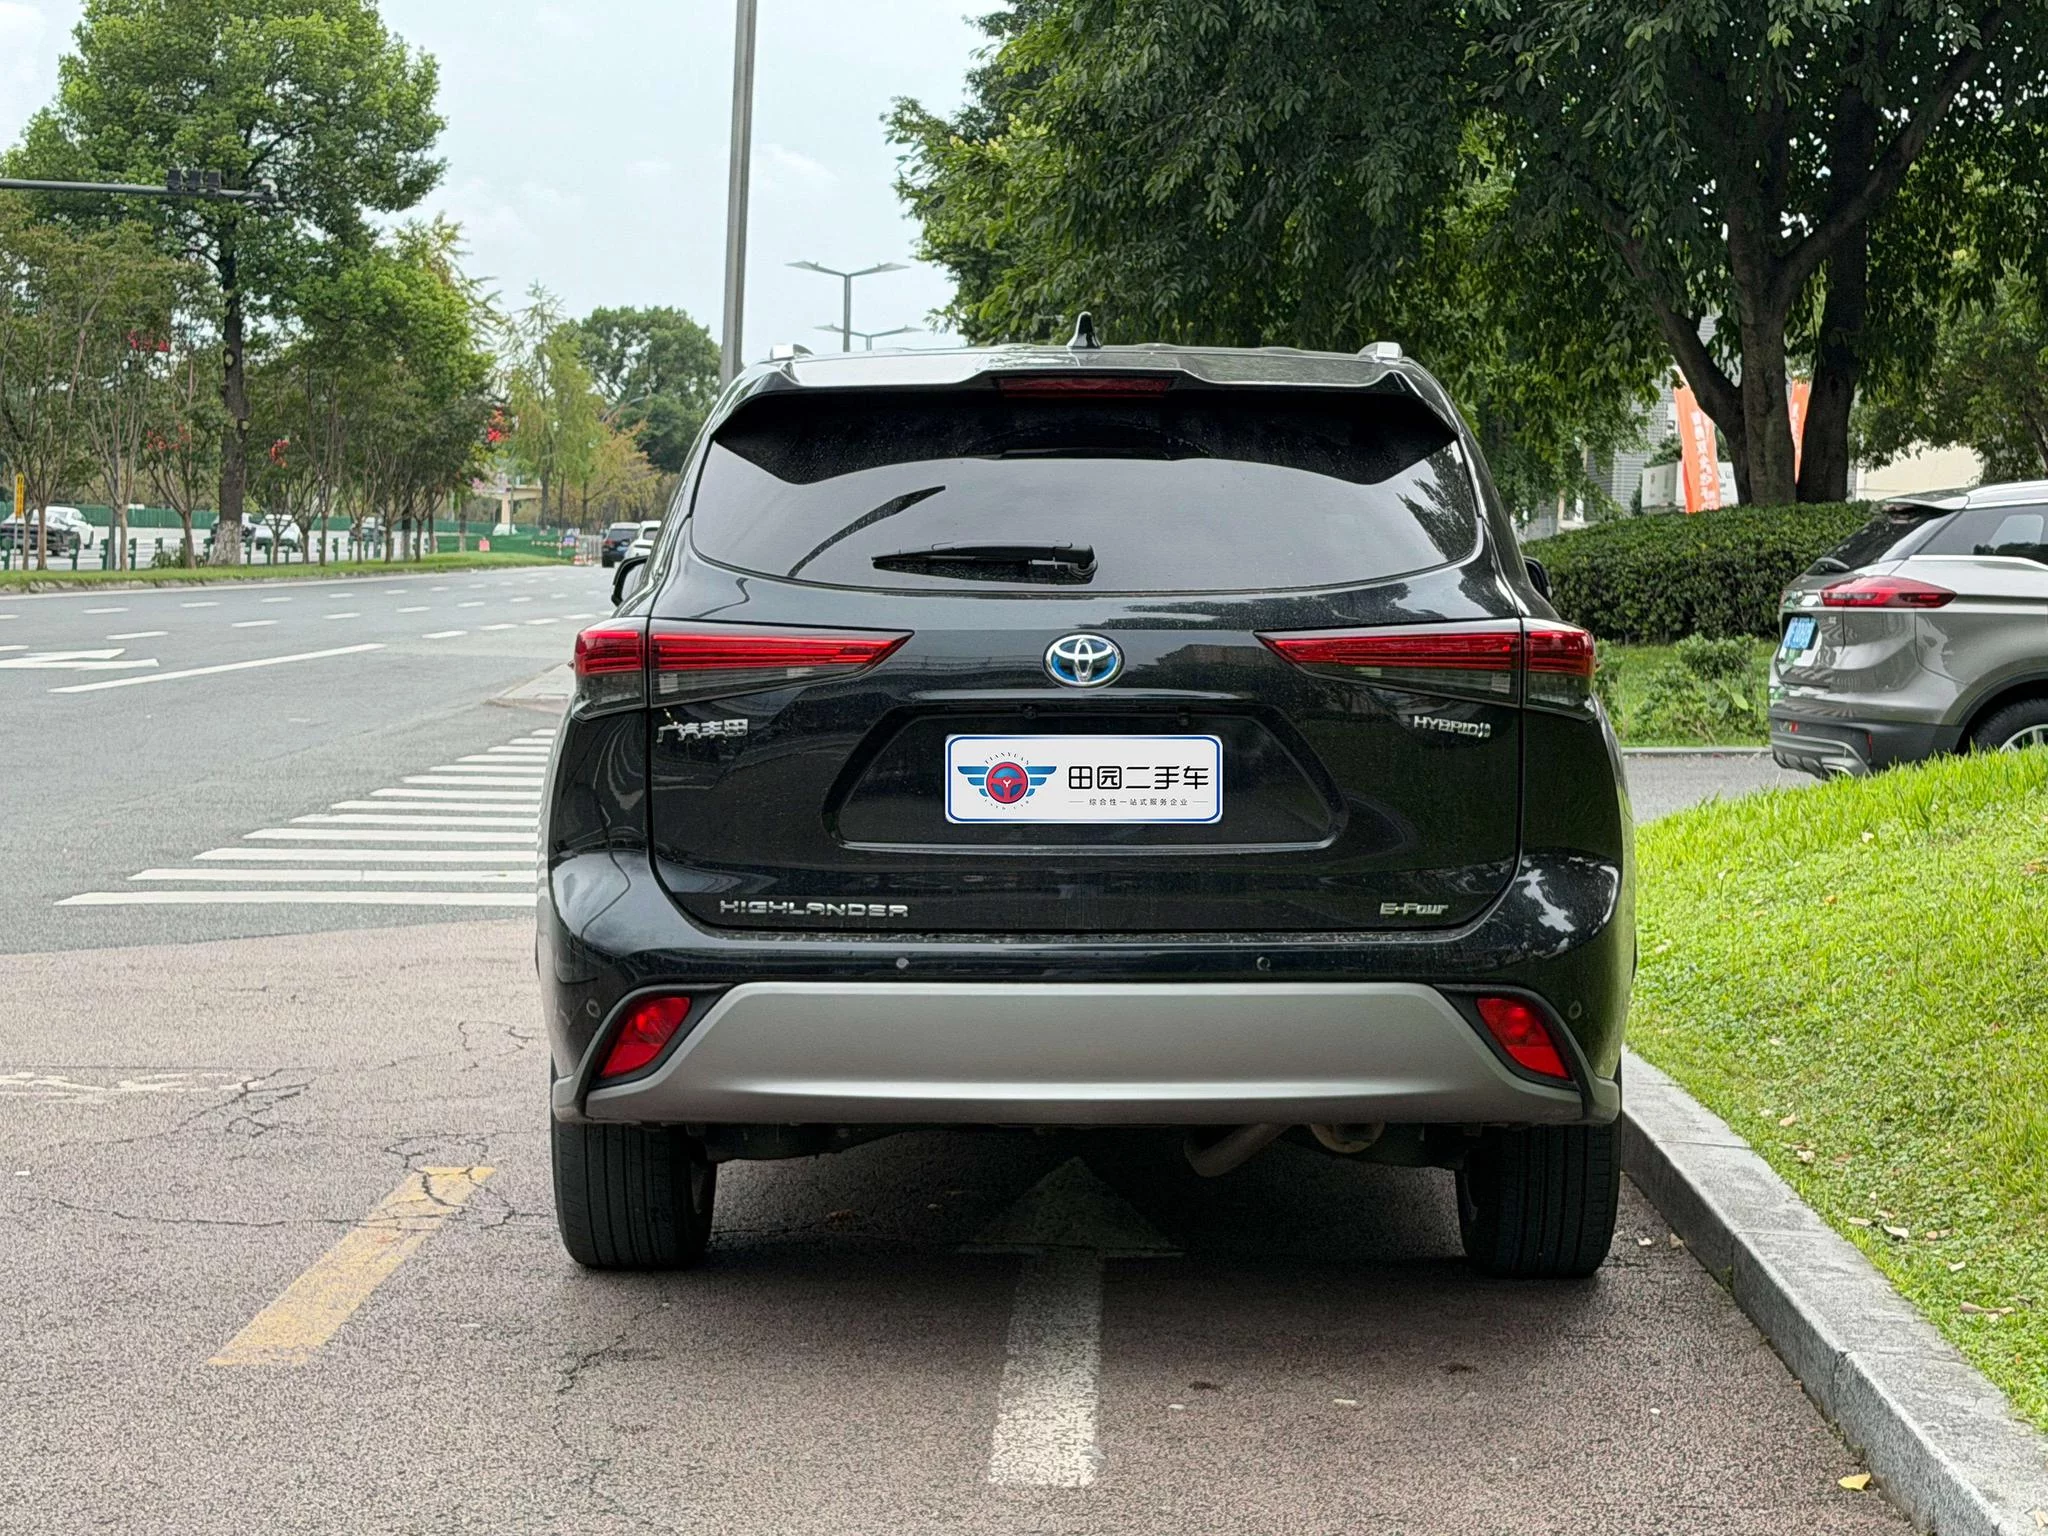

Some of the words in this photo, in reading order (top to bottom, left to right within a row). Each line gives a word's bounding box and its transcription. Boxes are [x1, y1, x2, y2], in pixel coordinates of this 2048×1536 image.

[1413, 715, 1479, 736] HYBRID
[719, 899, 909, 918] HIGHLANDER
[1379, 902, 1449, 915] E-Four
